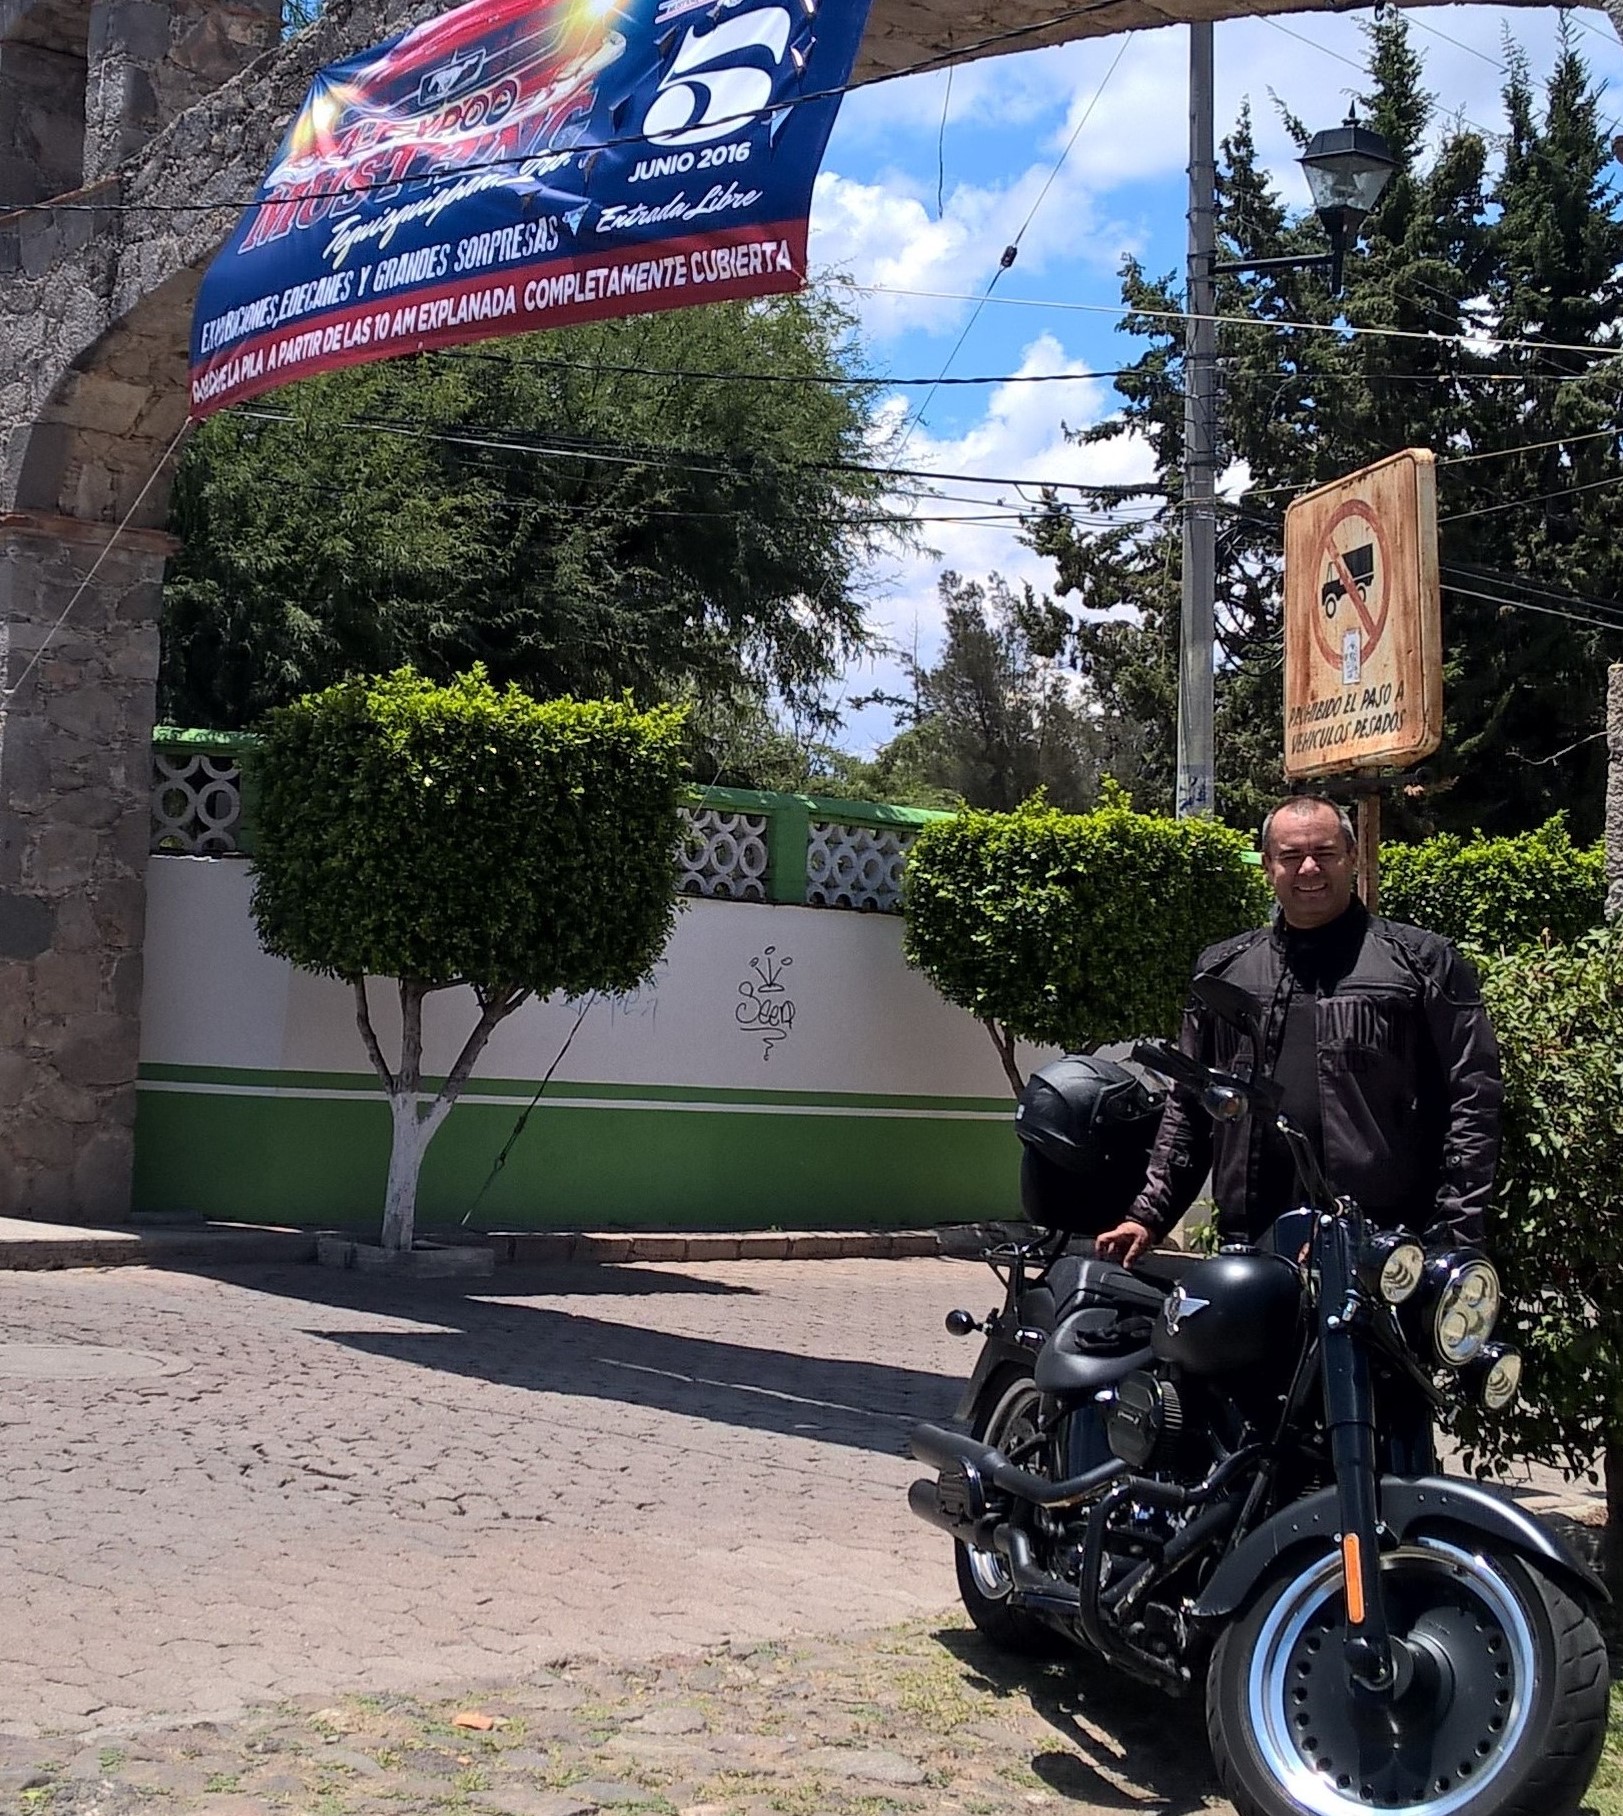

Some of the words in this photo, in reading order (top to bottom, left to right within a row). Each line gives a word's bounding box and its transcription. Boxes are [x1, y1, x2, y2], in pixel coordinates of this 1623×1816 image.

[643, 6, 791, 146] 5
[628, 152, 695, 183] JUNIO
[696, 141, 752, 169] 2016
[595, 191, 691, 233] Entrada
[682, 181, 764, 221] Libre
[357, 264, 373, 297] Y
[372, 243, 451, 292] GRANDES
[453, 215, 559, 272] SORPRESAS
[227, 358, 241, 388] LA
[240, 348, 264, 382] PILA
[265, 343, 277, 372] A
[277, 330, 322, 368] PARTIR
[322, 323, 342, 354] DE
[343, 316, 371, 349] LAS
[374, 311, 391, 342] 10
[391, 305, 417, 338] AM
[417, 285, 516, 332] EXPLANADA
[524, 255, 688, 311] COMPLETAMENTE
[690, 239, 793, 284] CUBIERTA
[1343, 692, 1357, 714] EL
[1360, 682, 1392, 711] PASO
[1394, 679, 1405, 702] A
[1291, 721, 1352, 755] VEHICULOS
[1352, 709, 1406, 740] PESADOS
